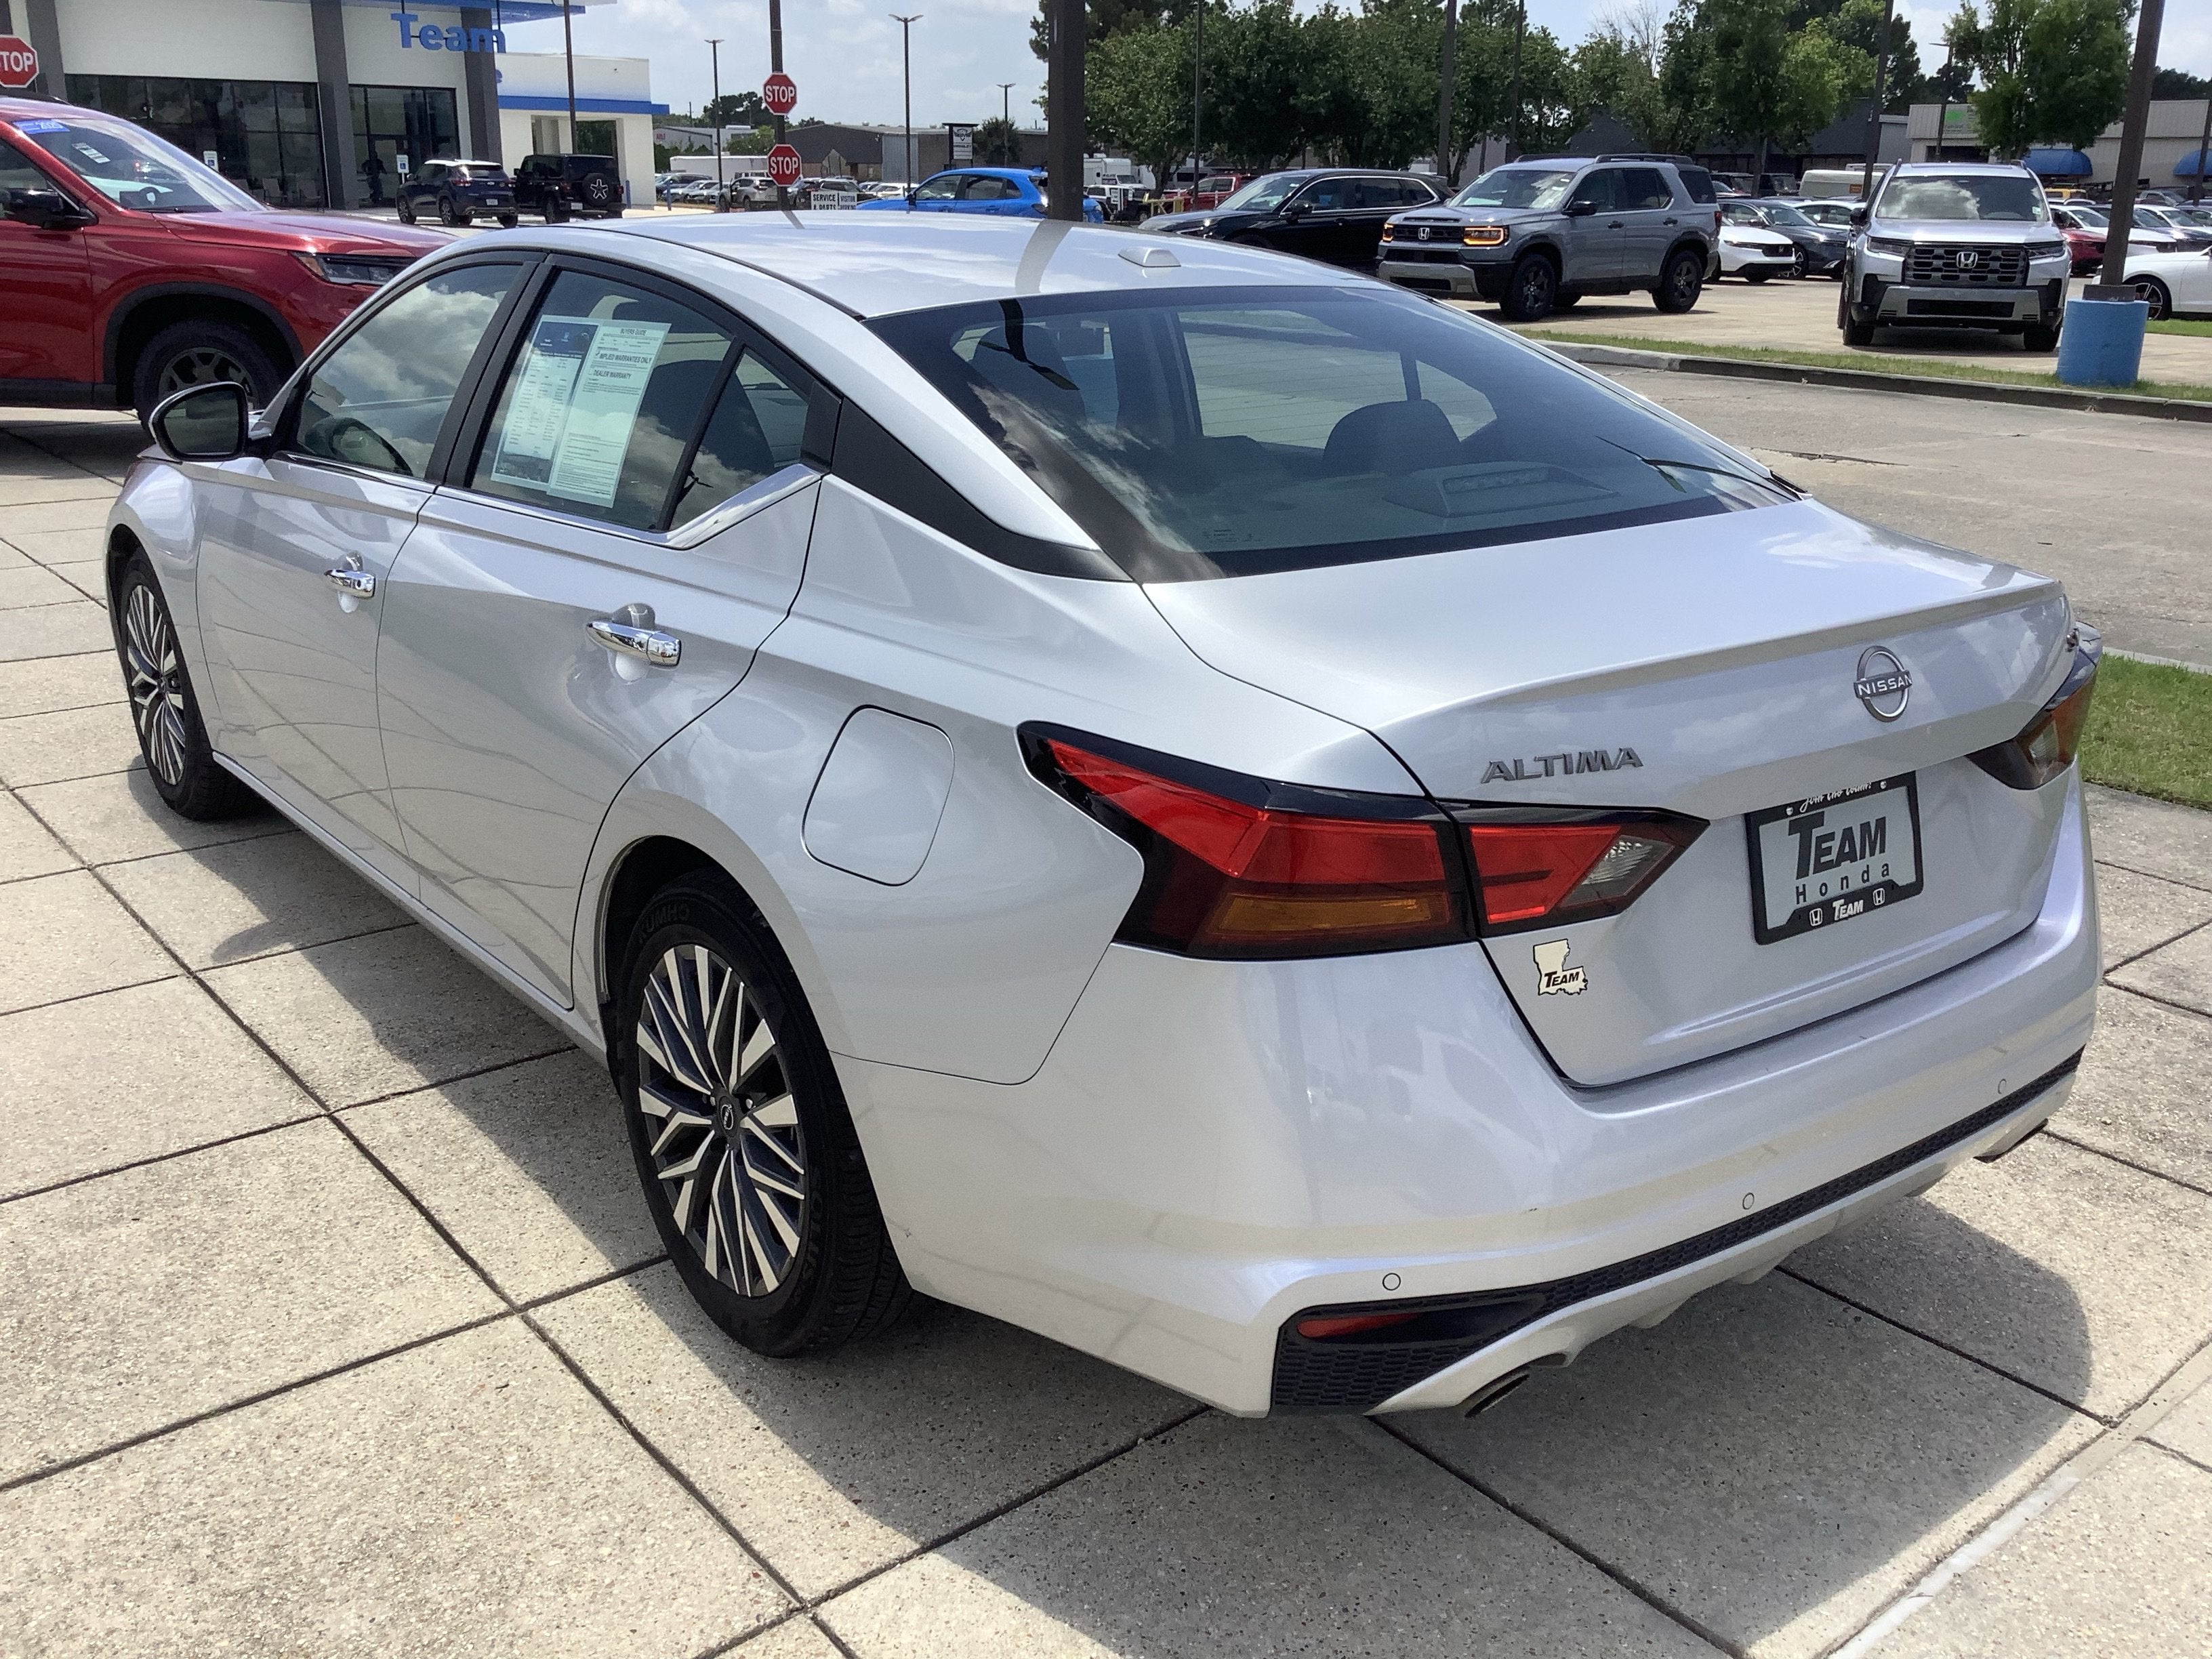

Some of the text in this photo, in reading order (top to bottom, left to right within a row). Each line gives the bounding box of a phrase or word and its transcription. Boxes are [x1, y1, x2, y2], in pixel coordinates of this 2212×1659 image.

[390, 12, 506, 54] Team
[0, 51, 34, 72] TOP
[765, 85, 796, 103] STOP
[770, 156, 799, 175] STOP
[813, 194, 836, 202] SERVICE
[615, 354, 641, 363] WARRANTIES
[593, 369, 632, 380] DEALER WARRANTY
[1858, 674, 1912, 695] NISSAN
[1480, 747, 1644, 784] ALTIMA
[1788, 811, 1887, 880] TEAM
[1795, 863, 1890, 905] Honda
[1832, 899, 1864, 921] TEAM
[1544, 970, 1580, 989] TEAM
